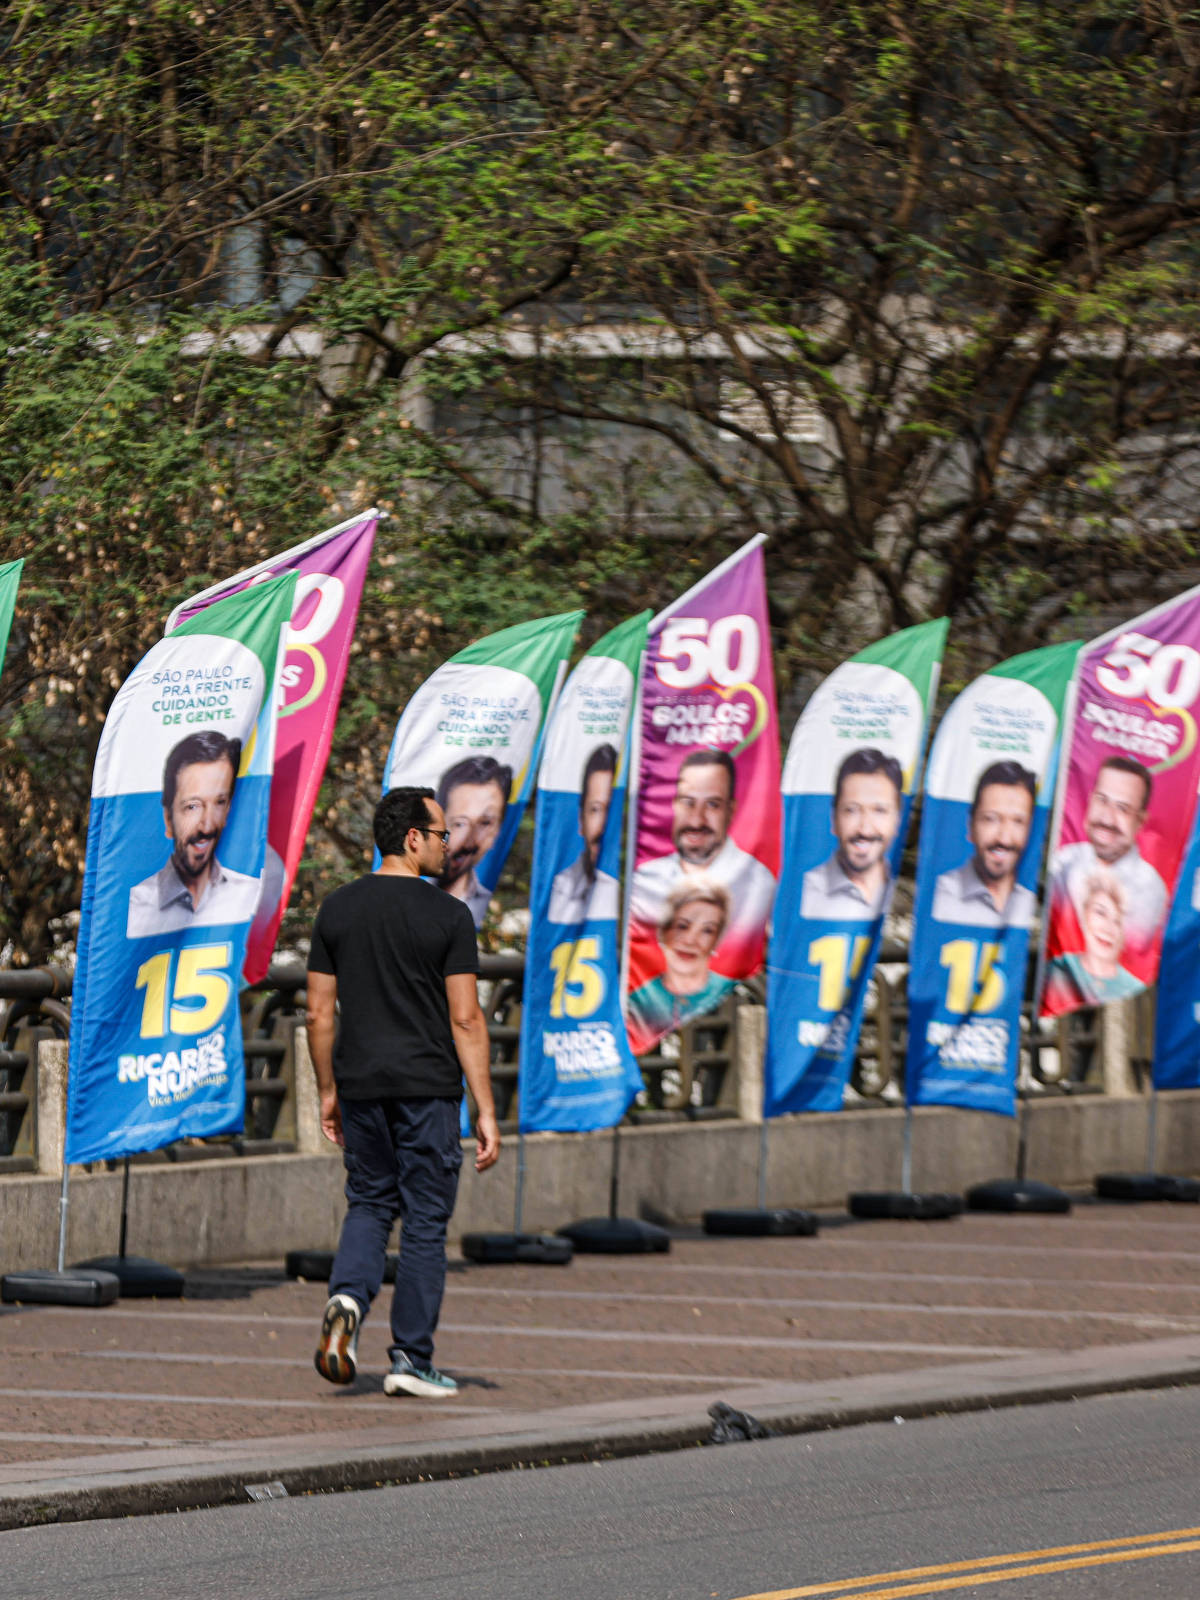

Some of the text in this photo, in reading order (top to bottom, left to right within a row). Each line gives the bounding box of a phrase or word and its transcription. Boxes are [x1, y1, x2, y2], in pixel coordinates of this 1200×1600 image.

[151, 665, 233, 685] SÃO PAULO
[162, 676, 253, 697] PRA FRENTE,
[653, 614, 761, 689] 50
[1095, 632, 1200, 709] 50
[151, 694, 229, 713] CUIDANDO
[162, 707, 236, 726] DE GENTE.
[134, 941, 233, 1040] 15
[549, 935, 608, 1019] 15
[938, 937, 1007, 1015] 15
